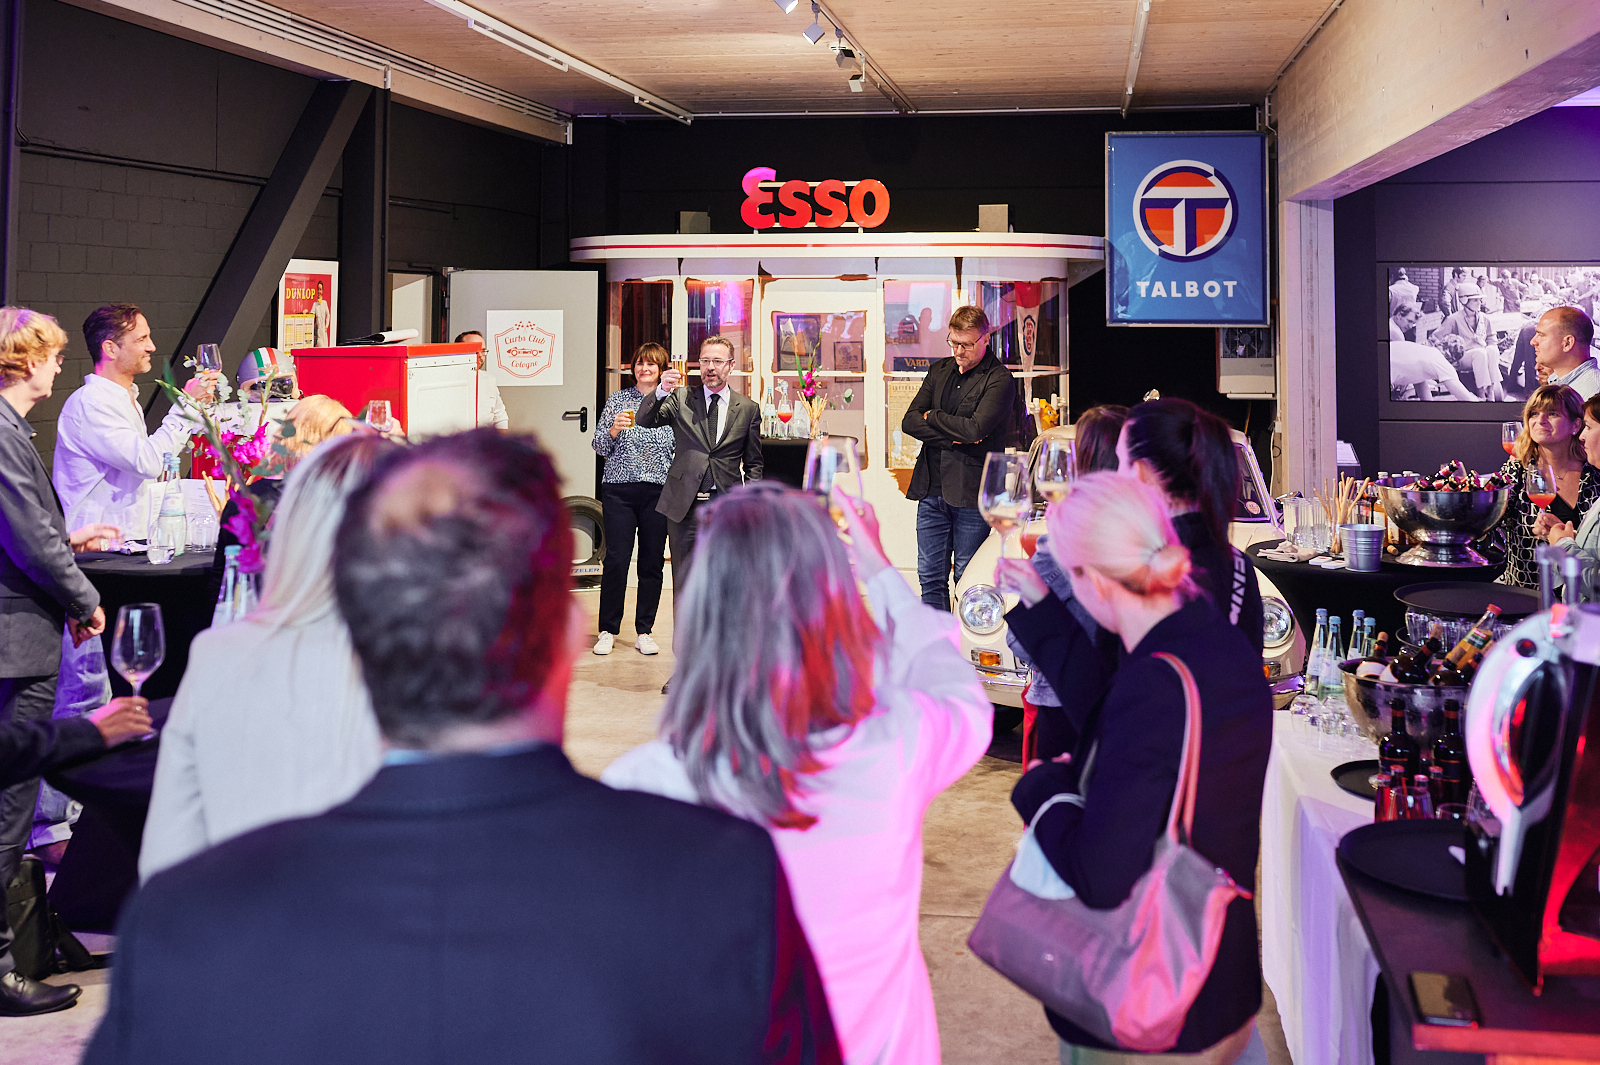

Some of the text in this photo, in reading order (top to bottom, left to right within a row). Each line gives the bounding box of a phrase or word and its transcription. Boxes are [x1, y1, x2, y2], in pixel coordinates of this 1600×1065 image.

[285, 287, 316, 300] DUNLOP
[1136, 280, 1238, 298] TALBOT
[504, 334, 546, 345] Curbs Club
[511, 359, 539, 370] Cologne
[903, 357, 931, 367] VARTA
